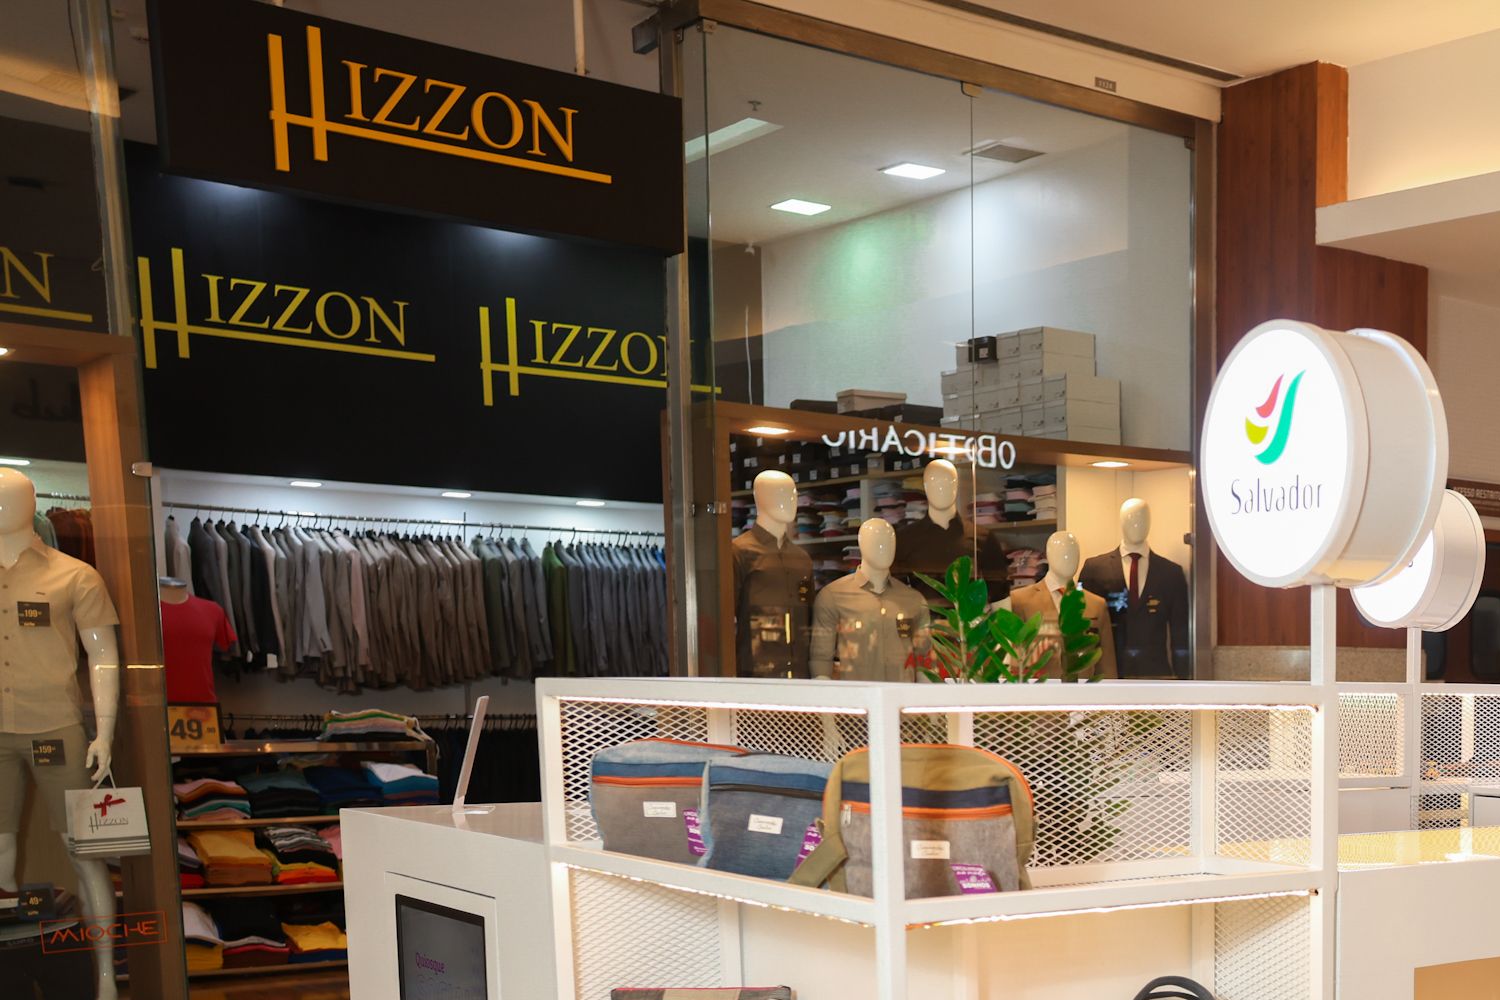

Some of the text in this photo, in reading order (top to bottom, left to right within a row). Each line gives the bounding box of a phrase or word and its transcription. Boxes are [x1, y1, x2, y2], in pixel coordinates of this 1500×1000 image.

[267, 25, 611, 172] HIZZON
[137, 247, 436, 369] HIZZON
[1230, 473, 1323, 515] Salvador
[171, 718, 203, 740] 49
